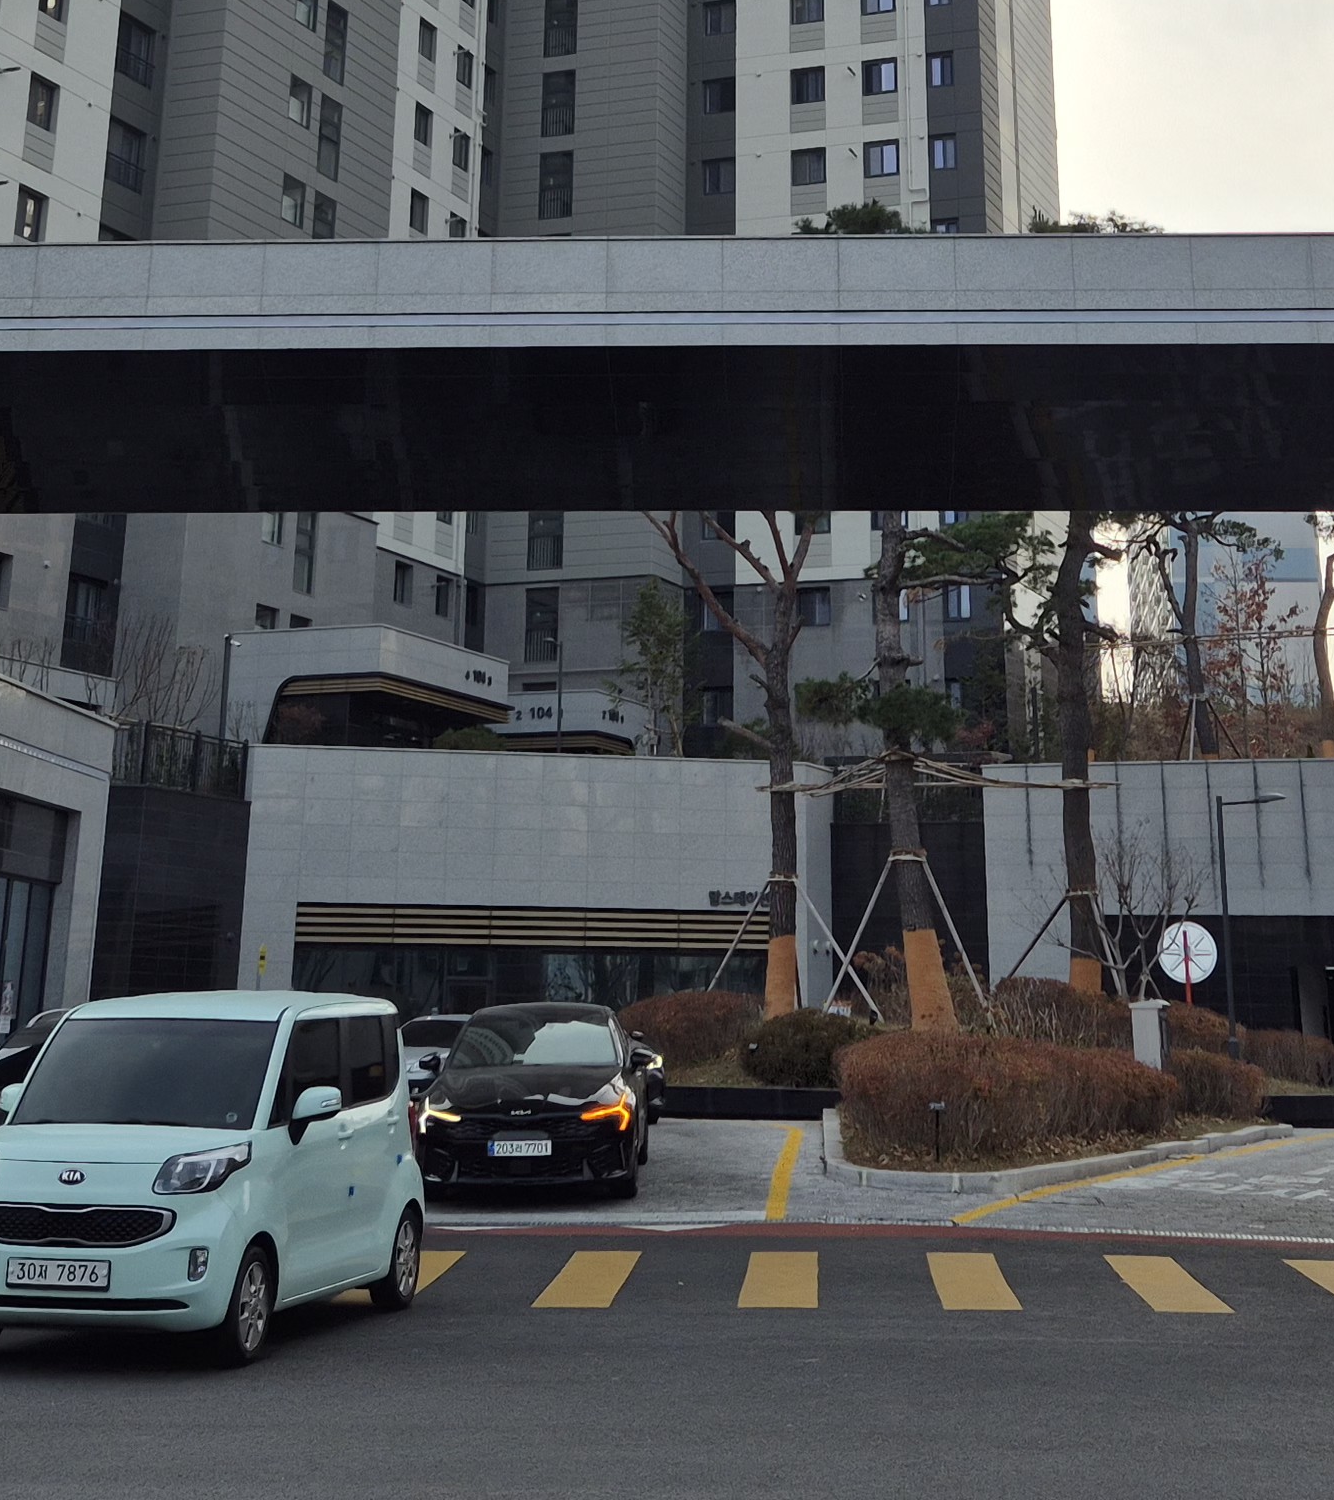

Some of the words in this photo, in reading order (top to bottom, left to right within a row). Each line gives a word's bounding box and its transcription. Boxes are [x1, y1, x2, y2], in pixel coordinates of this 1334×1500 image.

[529, 706, 553, 721] 104
[524, 1142, 549, 1154] 7701
[61, 1171, 83, 1181] KIA
[56, 1264, 99, 1283] 7876
